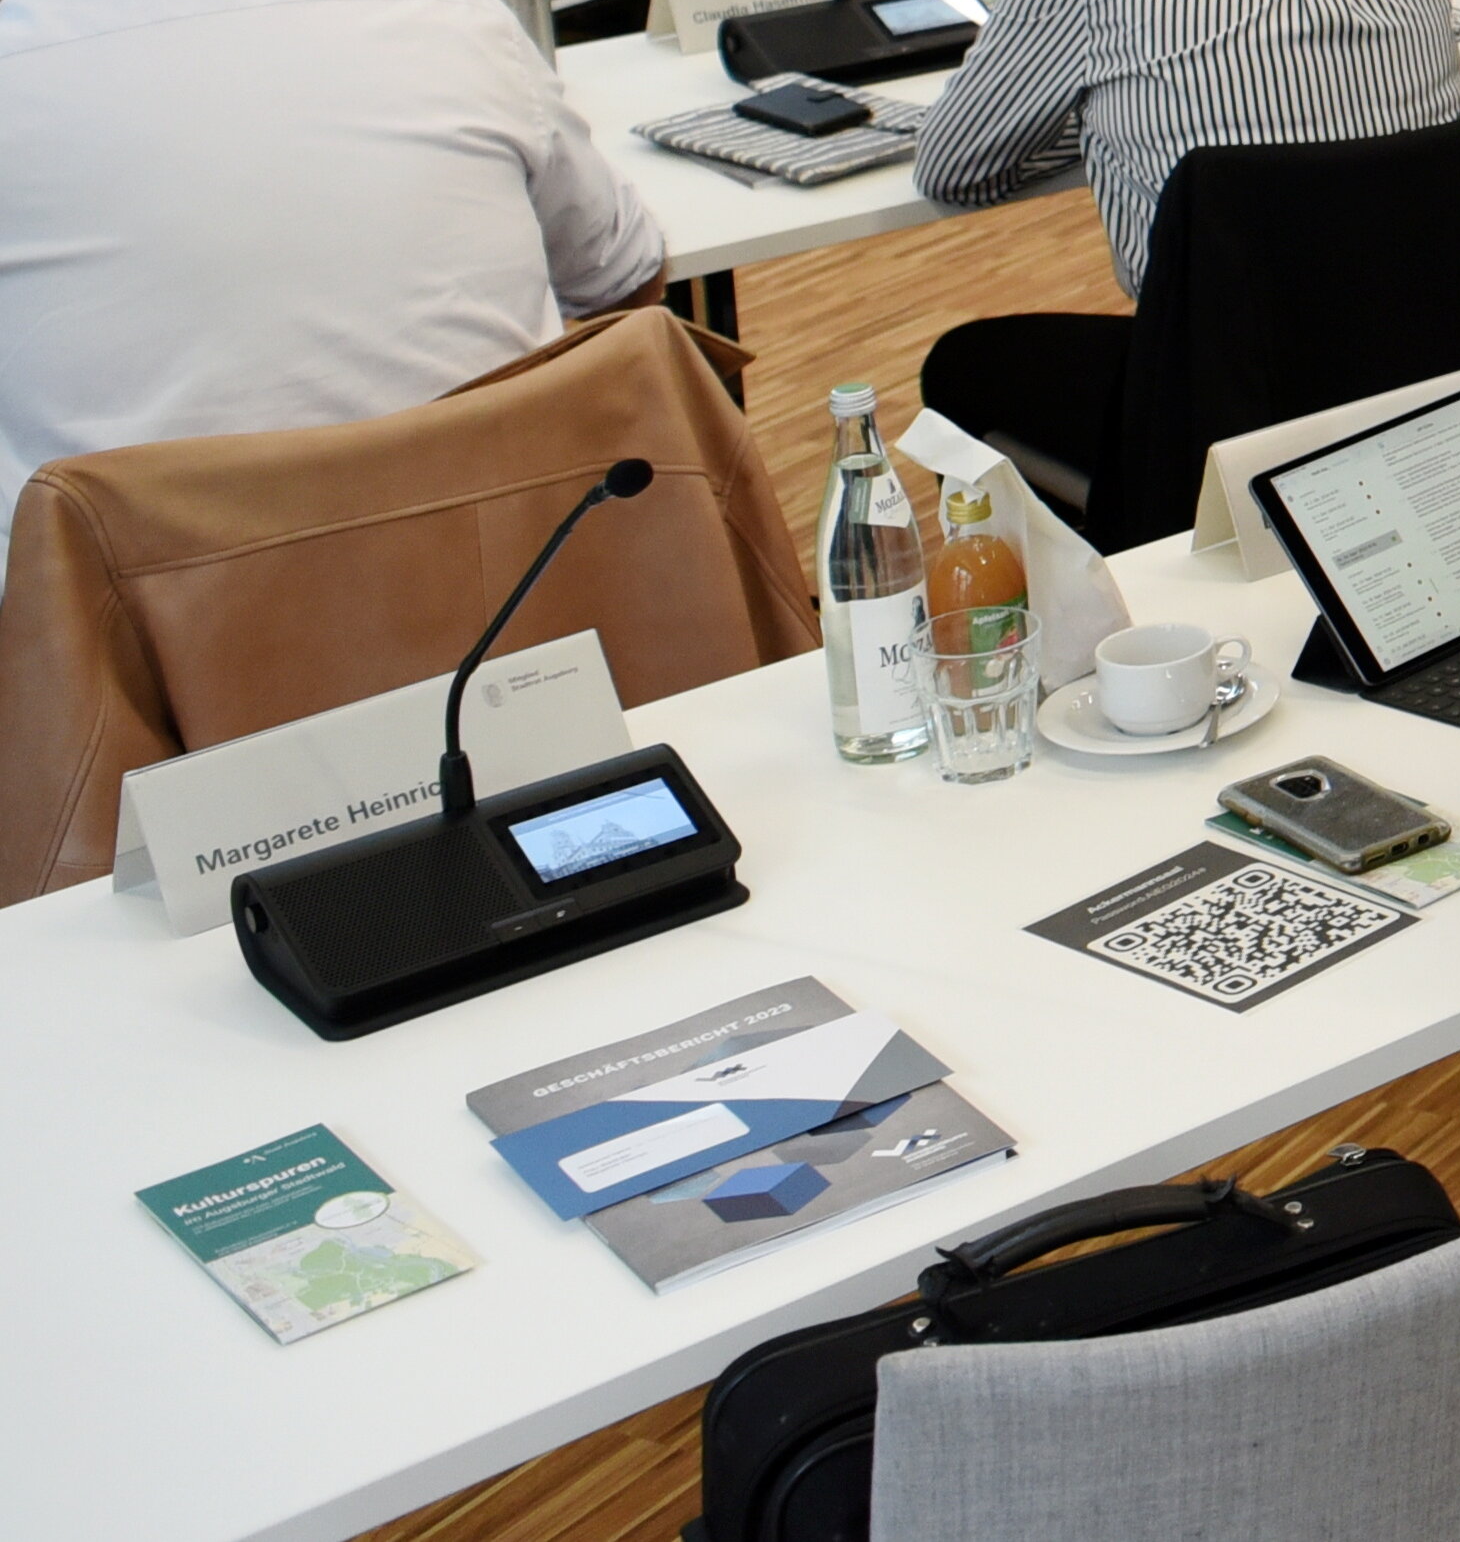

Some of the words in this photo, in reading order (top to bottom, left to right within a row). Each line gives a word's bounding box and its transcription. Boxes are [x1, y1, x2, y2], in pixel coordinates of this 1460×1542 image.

[195, 812, 341, 876] Margarete
[346, 779, 446, 825] Heinric
[531, 1020, 741, 1099] GESCHÄFTSBERICHT
[742, 1001, 794, 1027] 2023
[173, 1153, 328, 1220] Kulturspuren
[204, 1187, 280, 1219] Augsburger
[280, 1160, 347, 1192] Stadtwald
